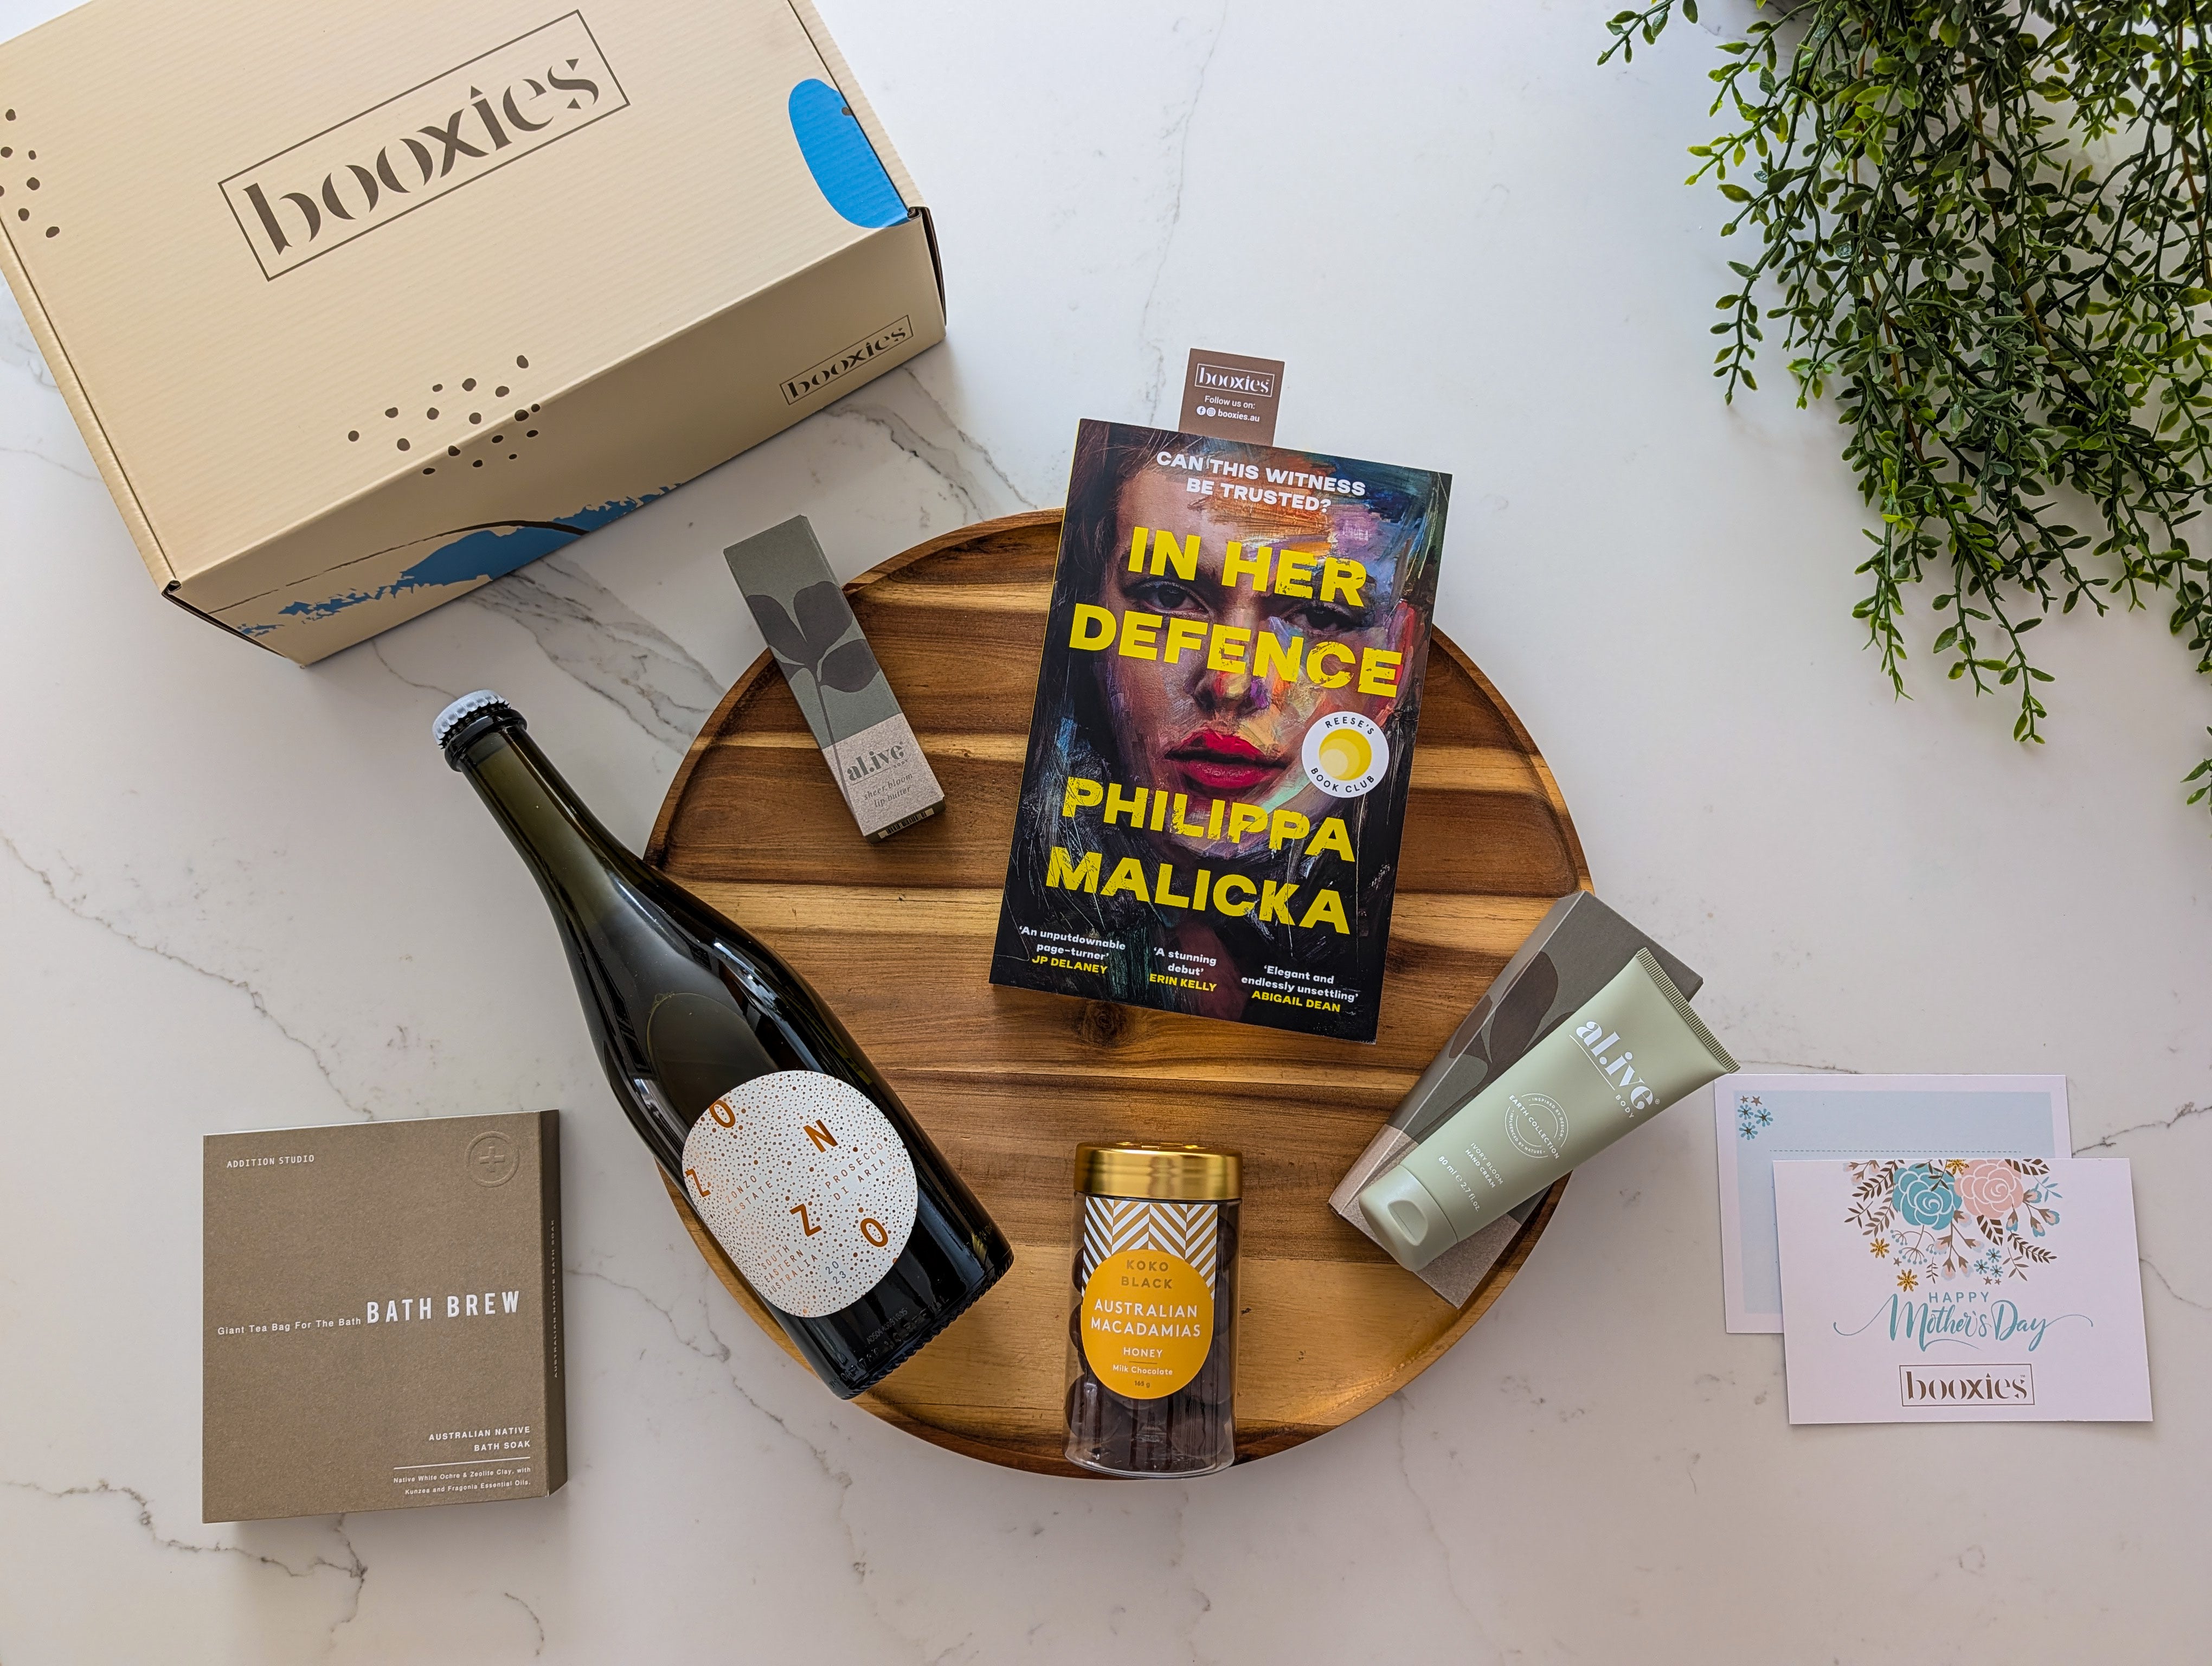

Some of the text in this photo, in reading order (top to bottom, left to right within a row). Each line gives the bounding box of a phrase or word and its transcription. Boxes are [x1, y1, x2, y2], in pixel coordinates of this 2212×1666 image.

[243, 58, 599, 255] booxies
[787, 326, 906, 400] booxies
[1199, 367, 1270, 394] booxies
[1204, 395, 1230, 406] Follow
[1218, 409, 1260, 422] booxies.au
[1156, 451, 1366, 496] CAN THIS WITNESS
[1186, 478, 1332, 513] BE TRUSTED?
[1128, 526, 1367, 607] IN HER
[1069, 603, 1403, 698] DEFENCE
[1324, 716, 1374, 735] REESE'S
[863, 773, 913, 800] sheer bloom
[1310, 767, 1374, 793] BOOK CLUB
[874, 786, 911, 808] lip butter
[1062, 776, 1355, 862] PHILIPPA
[1045, 847, 1351, 935] MALICKA
[1040, 931, 1126, 950] unputdownable
[1032, 955, 1108, 974] JP DELANEY
[1168, 950, 1217, 967] stunning
[1149, 973, 1218, 992] ERIN KELLY
[1241, 976, 1295, 992] endlessly
[1312, 974, 1334, 984] and
[1251, 990, 1341, 1013] ABIGAIL DEAN
[1615, 1094, 1635, 1118] BODY
[1509, 1094, 1560, 1159] EARTH COLLECTION
[226, 1155, 314, 1169] ADDITION STUDIO
[1524, 1146, 1543, 1155] NATURE
[825, 1142, 884, 1190] PROSECCO
[1438, 1156, 1448, 1165] 80
[1446, 1165, 1455, 1176] ml
[1460, 1182, 1471, 1193] 2.7
[1465, 1149, 1496, 1188] HAND CREAM
[1470, 1142, 1504, 1185] IVORY BLOOM
[724, 1175, 757, 1204] ZONZO
[833, 1159, 886, 1201] DI ARIA
[733, 1180, 773, 1215] ESTATE
[761, 1245, 790, 1271] SOUTH
[765, 1249, 803, 1283] EASTERN
[825, 1261, 839, 1275] 20
[1126, 1259, 1169, 1272] KOKO
[768, 1254, 819, 1296] AUSTRALIA
[833, 1271, 846, 1285] 23
[1121, 1276, 1173, 1289] BLACK
[366, 1290, 519, 1324] BATH BREW
[1094, 1298, 1198, 1318] AUSTRALIAN
[1928, 1291, 1990, 1303] HAPPY
[217, 1316, 361, 1336] Giant Tea Bag For The Bath
[1091, 1316, 1201, 1337] MACADAMIAS
[1834, 1293, 1993, 1352] Mother's
[1123, 1347, 1163, 1358] HONEY
[1113, 1363, 1173, 1376] Milk Chocolate
[1905, 1370, 2027, 1401] booxies
[428, 1426, 531, 1441] AUSTRALIAN NATIVE
[474, 1440, 531, 1452] BATH SOAK
[447, 1484, 478, 1492] Fragonia
